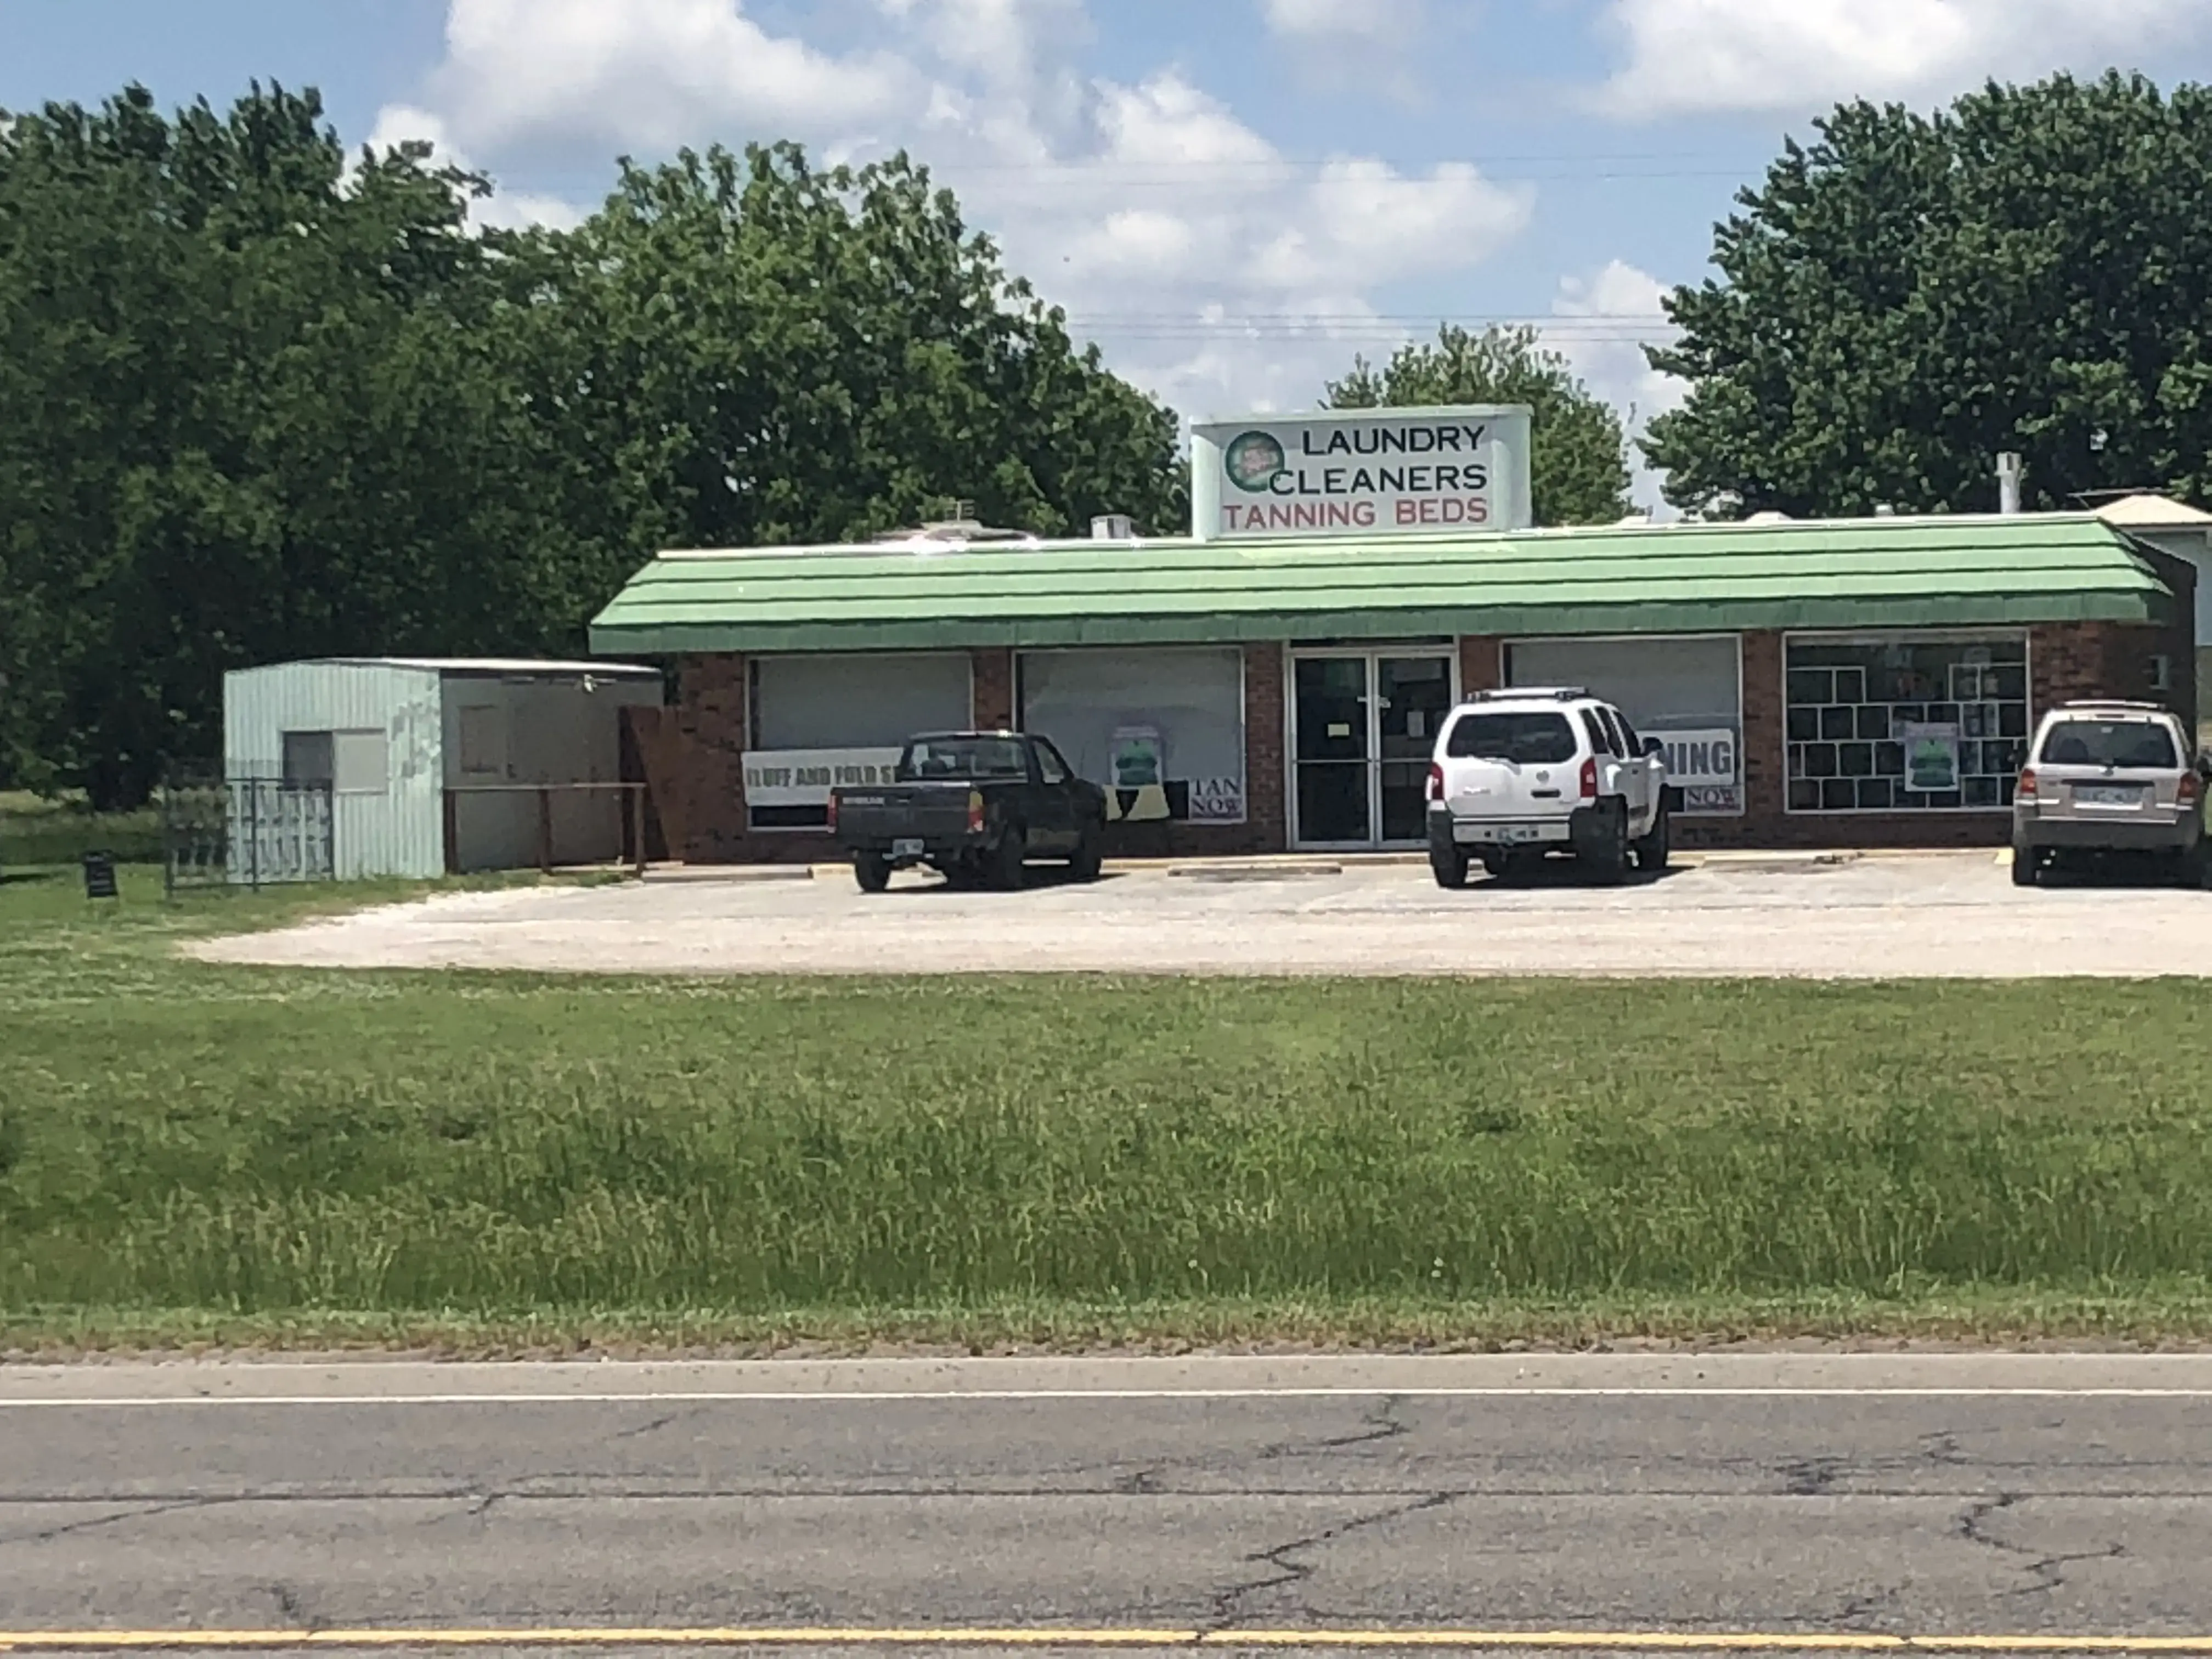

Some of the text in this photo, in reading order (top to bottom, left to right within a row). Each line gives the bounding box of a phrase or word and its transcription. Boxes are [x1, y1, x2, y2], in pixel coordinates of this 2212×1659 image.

[1302, 425, 1485, 455] LAUNDRY
[1269, 464, 1487, 495] CLEANERS
[1224, 498, 1487, 529] TANNING BEDS
[1657, 741, 1731, 775] NING
[795, 767, 830, 786] AND
[1192, 778, 1240, 795] TAN
